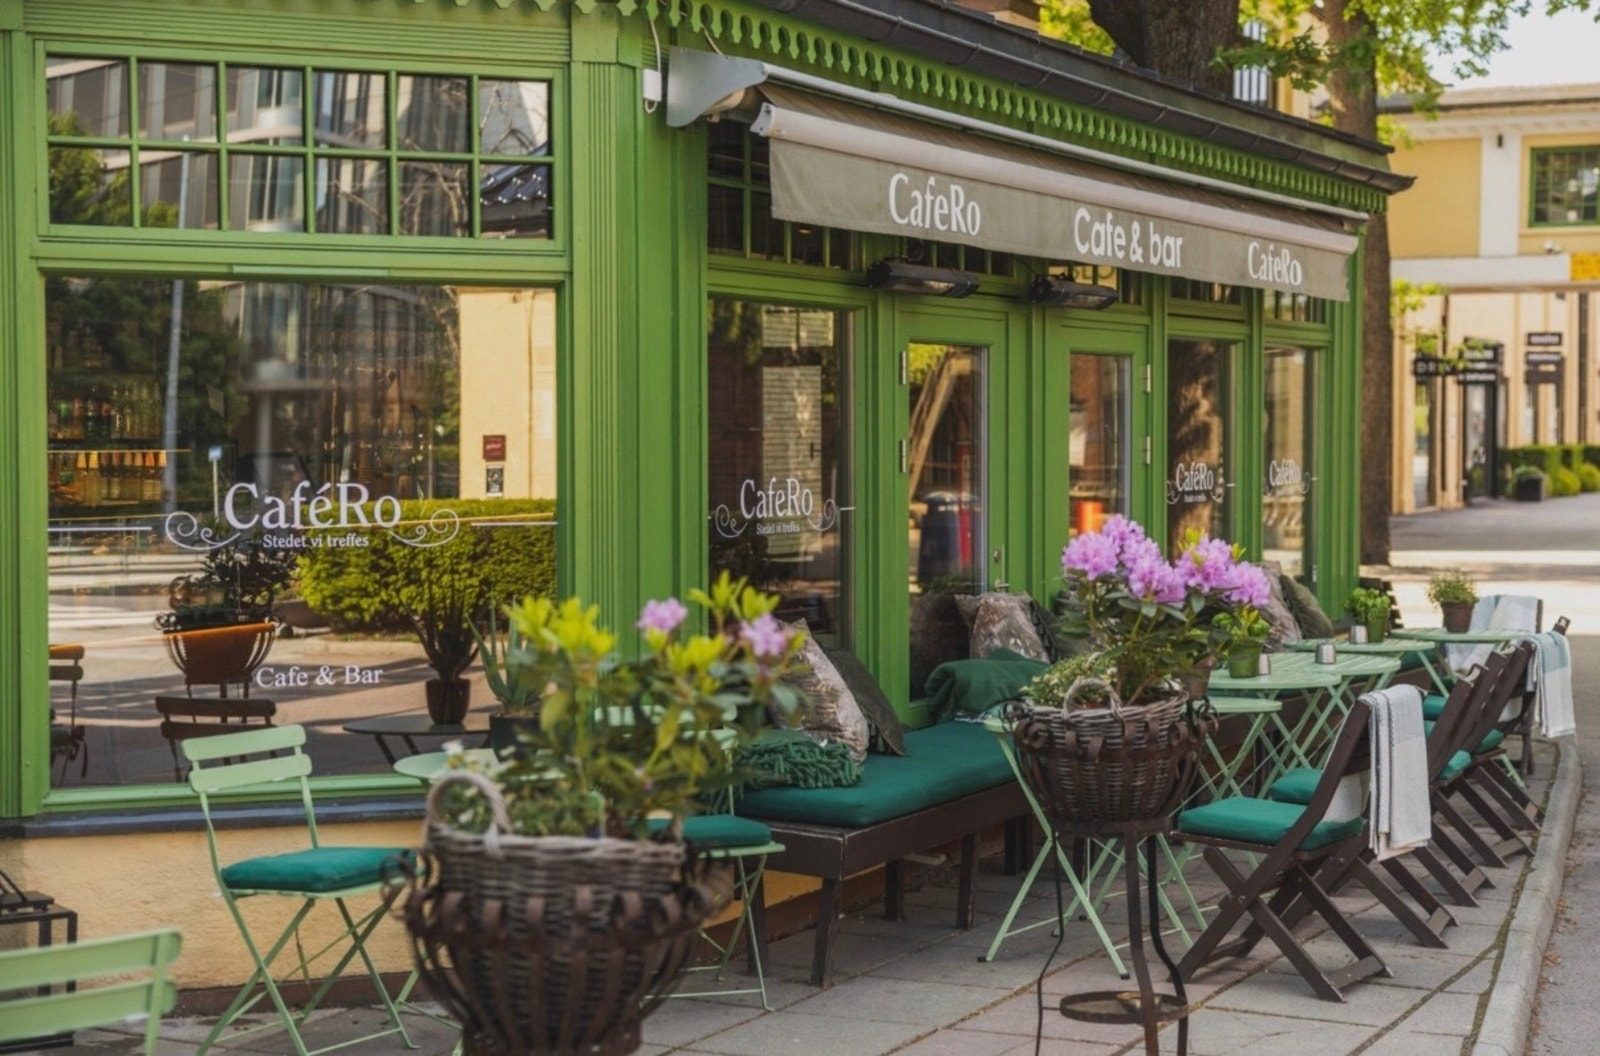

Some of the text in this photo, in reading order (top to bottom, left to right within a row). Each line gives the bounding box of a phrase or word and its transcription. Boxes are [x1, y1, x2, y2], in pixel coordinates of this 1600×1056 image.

[888, 172, 981, 236] CafeRo
[1073, 207, 1183, 269] Cafe & bar
[1247, 241, 1303, 286] CafeRo
[224, 480, 402, 531] CaféRo
[263, 532, 369, 548] Stedet vi treffes
[255, 665, 384, 688] Cafe & Bar
